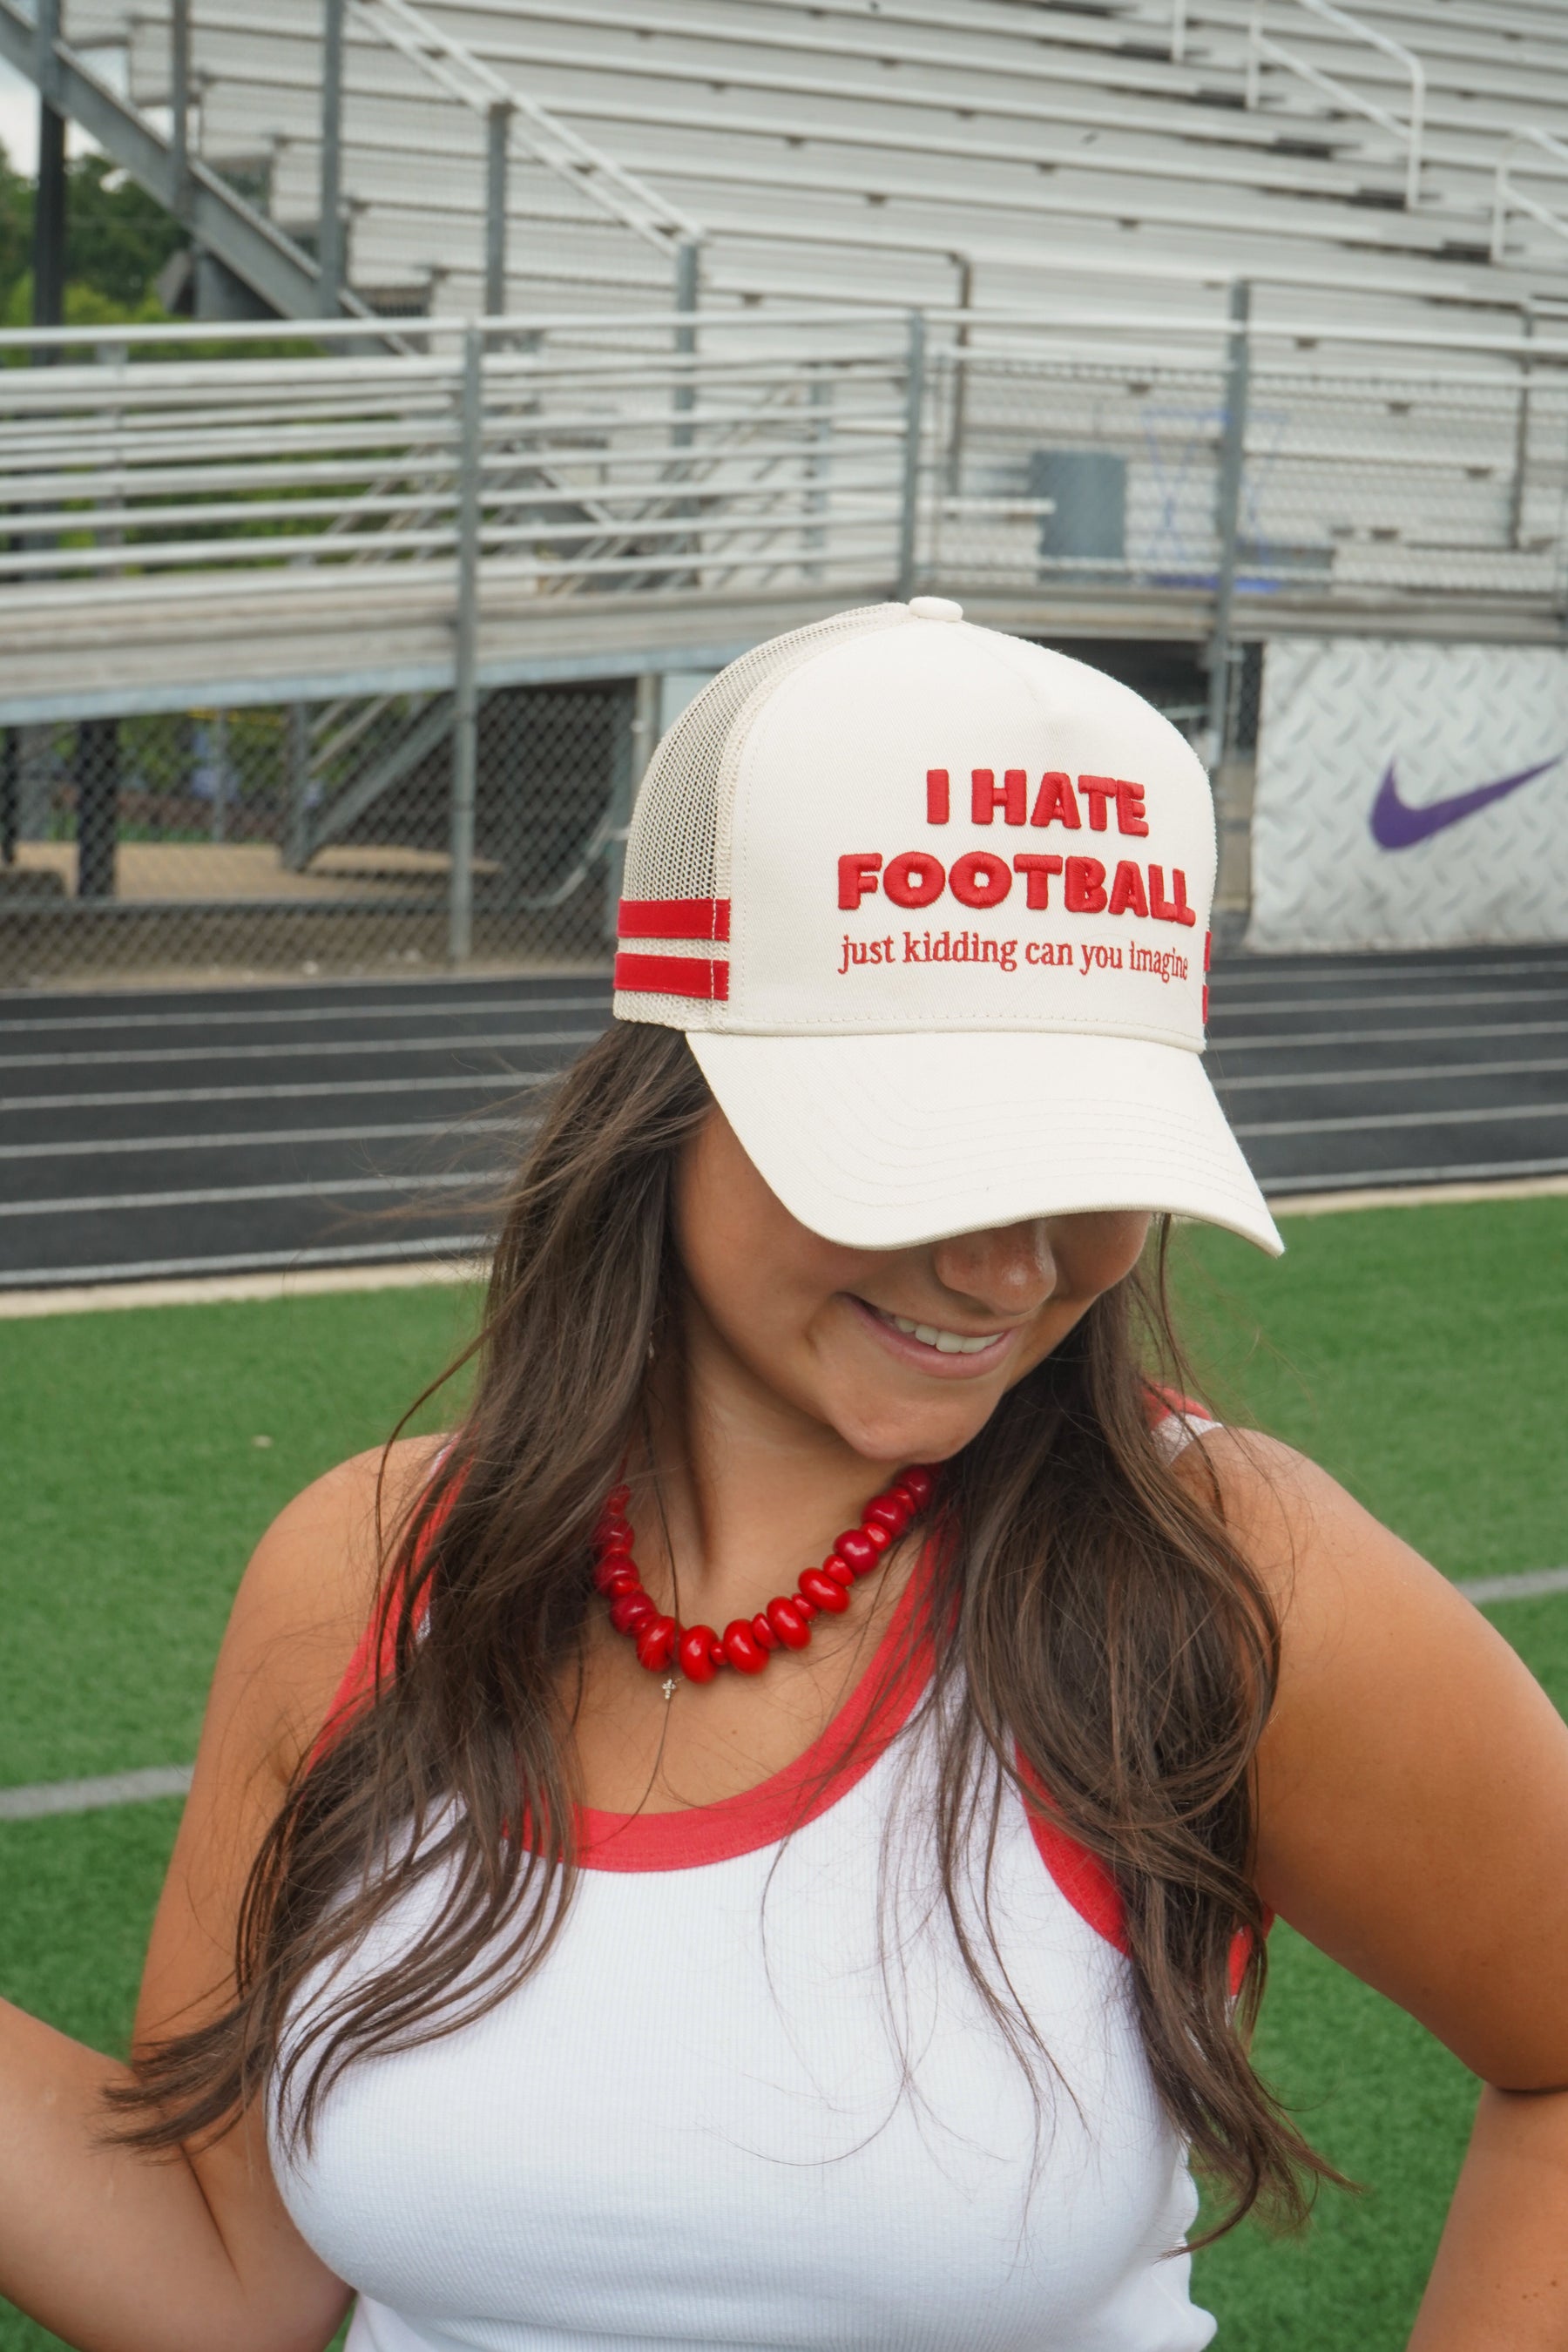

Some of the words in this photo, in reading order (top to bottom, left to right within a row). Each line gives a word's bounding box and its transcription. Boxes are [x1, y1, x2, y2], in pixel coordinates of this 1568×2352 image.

[926, 768, 950, 825] I
[970, 768, 1149, 837] HATE
[837, 850, 1197, 927] FOOTBALL
[837, 935, 896, 974] just
[902, 930, 1017, 972] kidding
[1024, 942, 1073, 966] can
[1079, 944, 1123, 976] you
[1130, 941, 1189, 983] imagine
